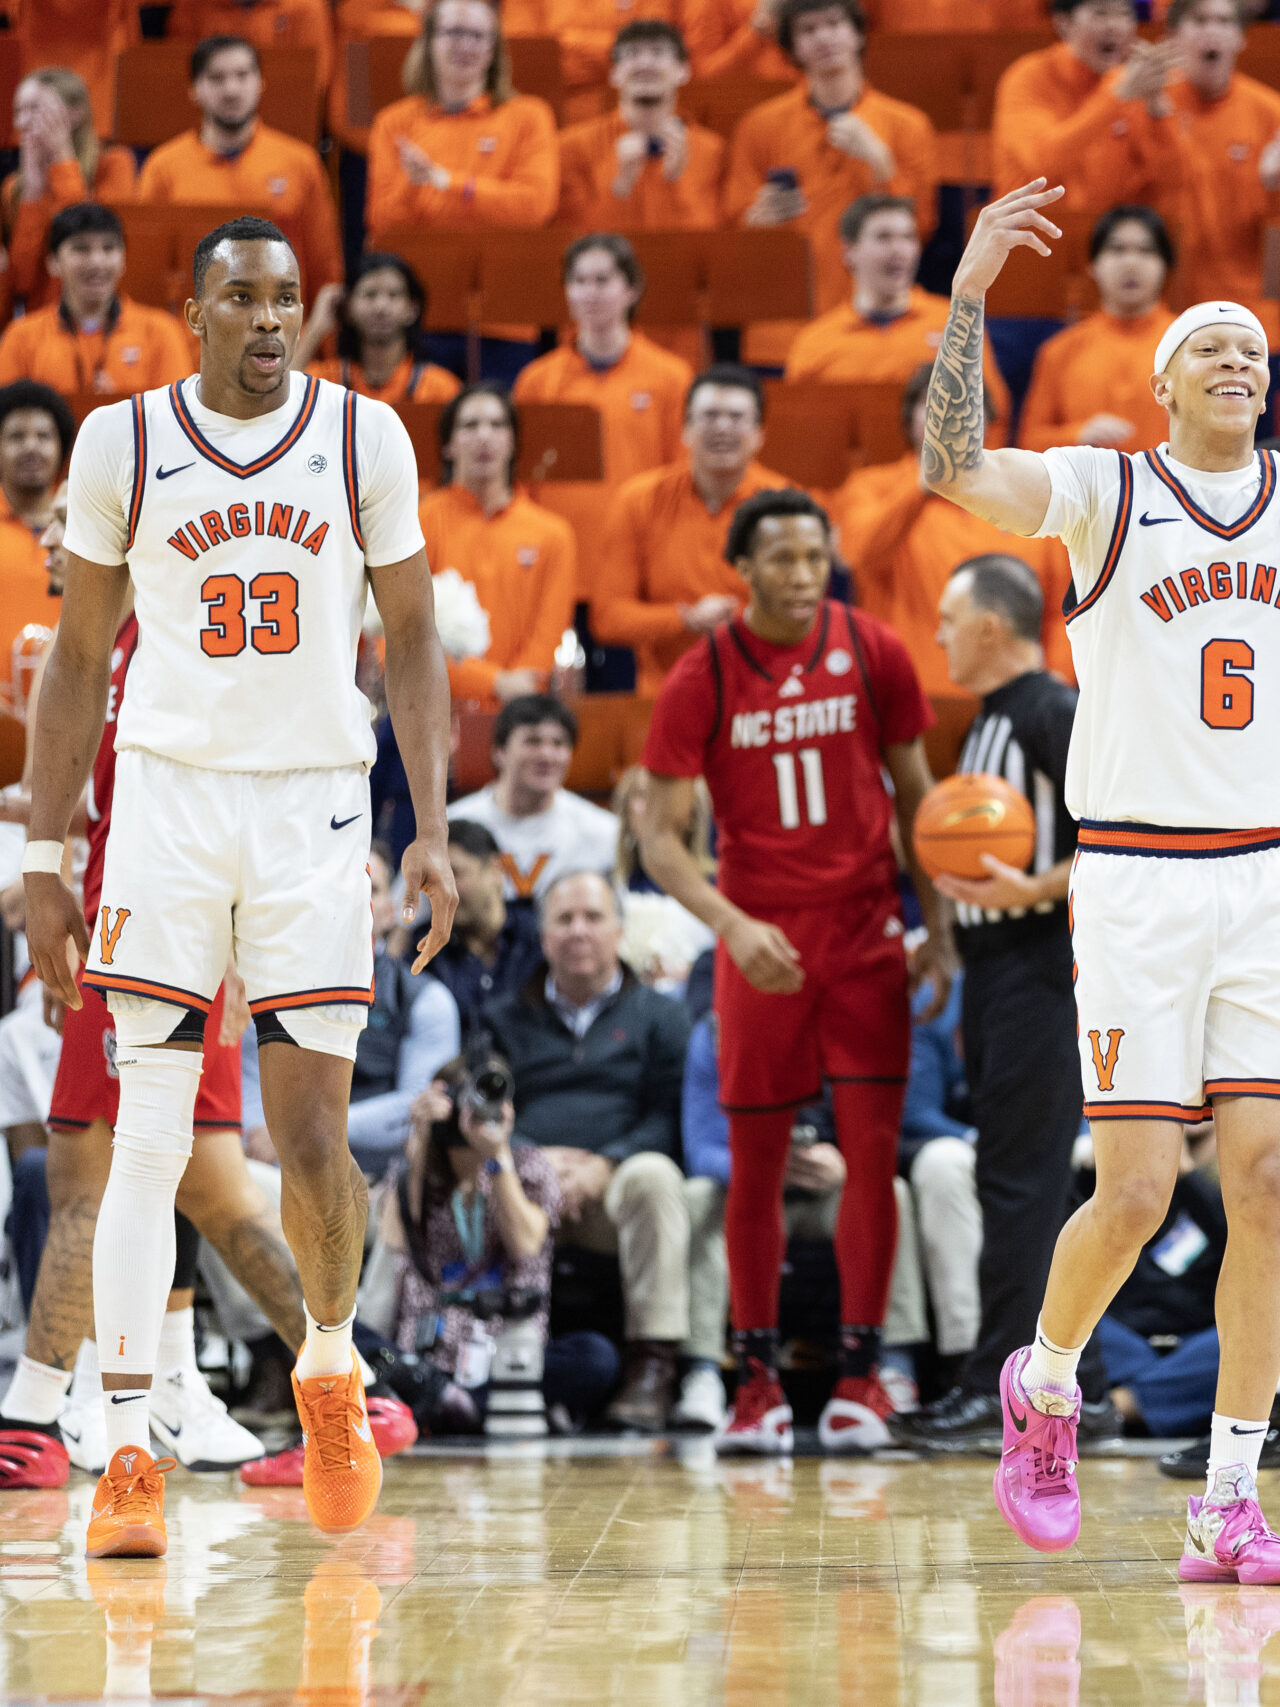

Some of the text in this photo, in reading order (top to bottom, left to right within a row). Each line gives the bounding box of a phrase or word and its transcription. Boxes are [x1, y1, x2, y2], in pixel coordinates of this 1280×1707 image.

[167, 501, 330, 562] VIRGINIA
[200, 572, 300, 658] 33
[1200, 638, 1255, 731] 6
[731, 693, 858, 749] NC STATE
[771, 747, 828, 830] 11
[100, 905, 132, 965] V
[1087, 1028, 1126, 1092] V
